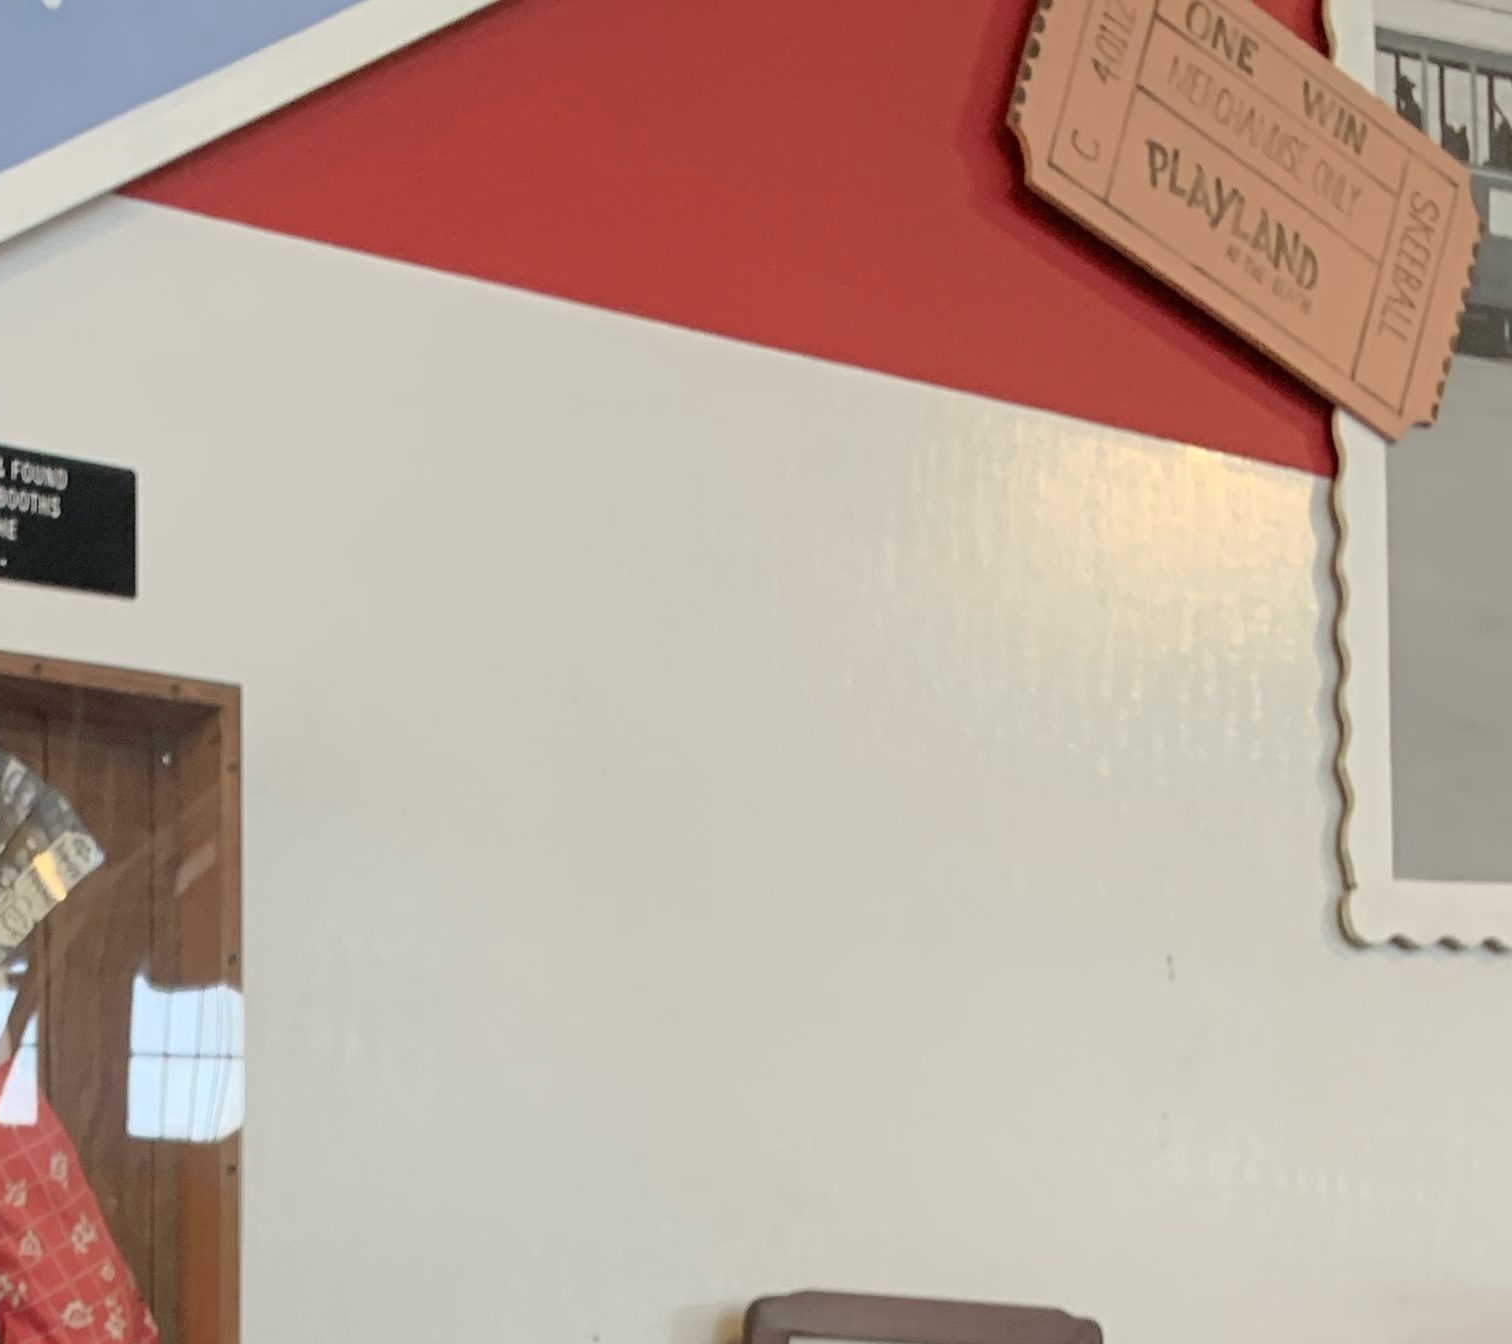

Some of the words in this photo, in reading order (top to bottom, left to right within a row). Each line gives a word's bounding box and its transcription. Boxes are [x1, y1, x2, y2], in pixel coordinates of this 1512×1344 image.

[1185, 1, 1259, 76] ONE
[1303, 79, 1368, 156] WIN
[1146, 138, 1320, 292] PLAYLAND
[1378, 190, 1441, 344] SKEEBALL
[10, 462, 68, 491] FOUND
